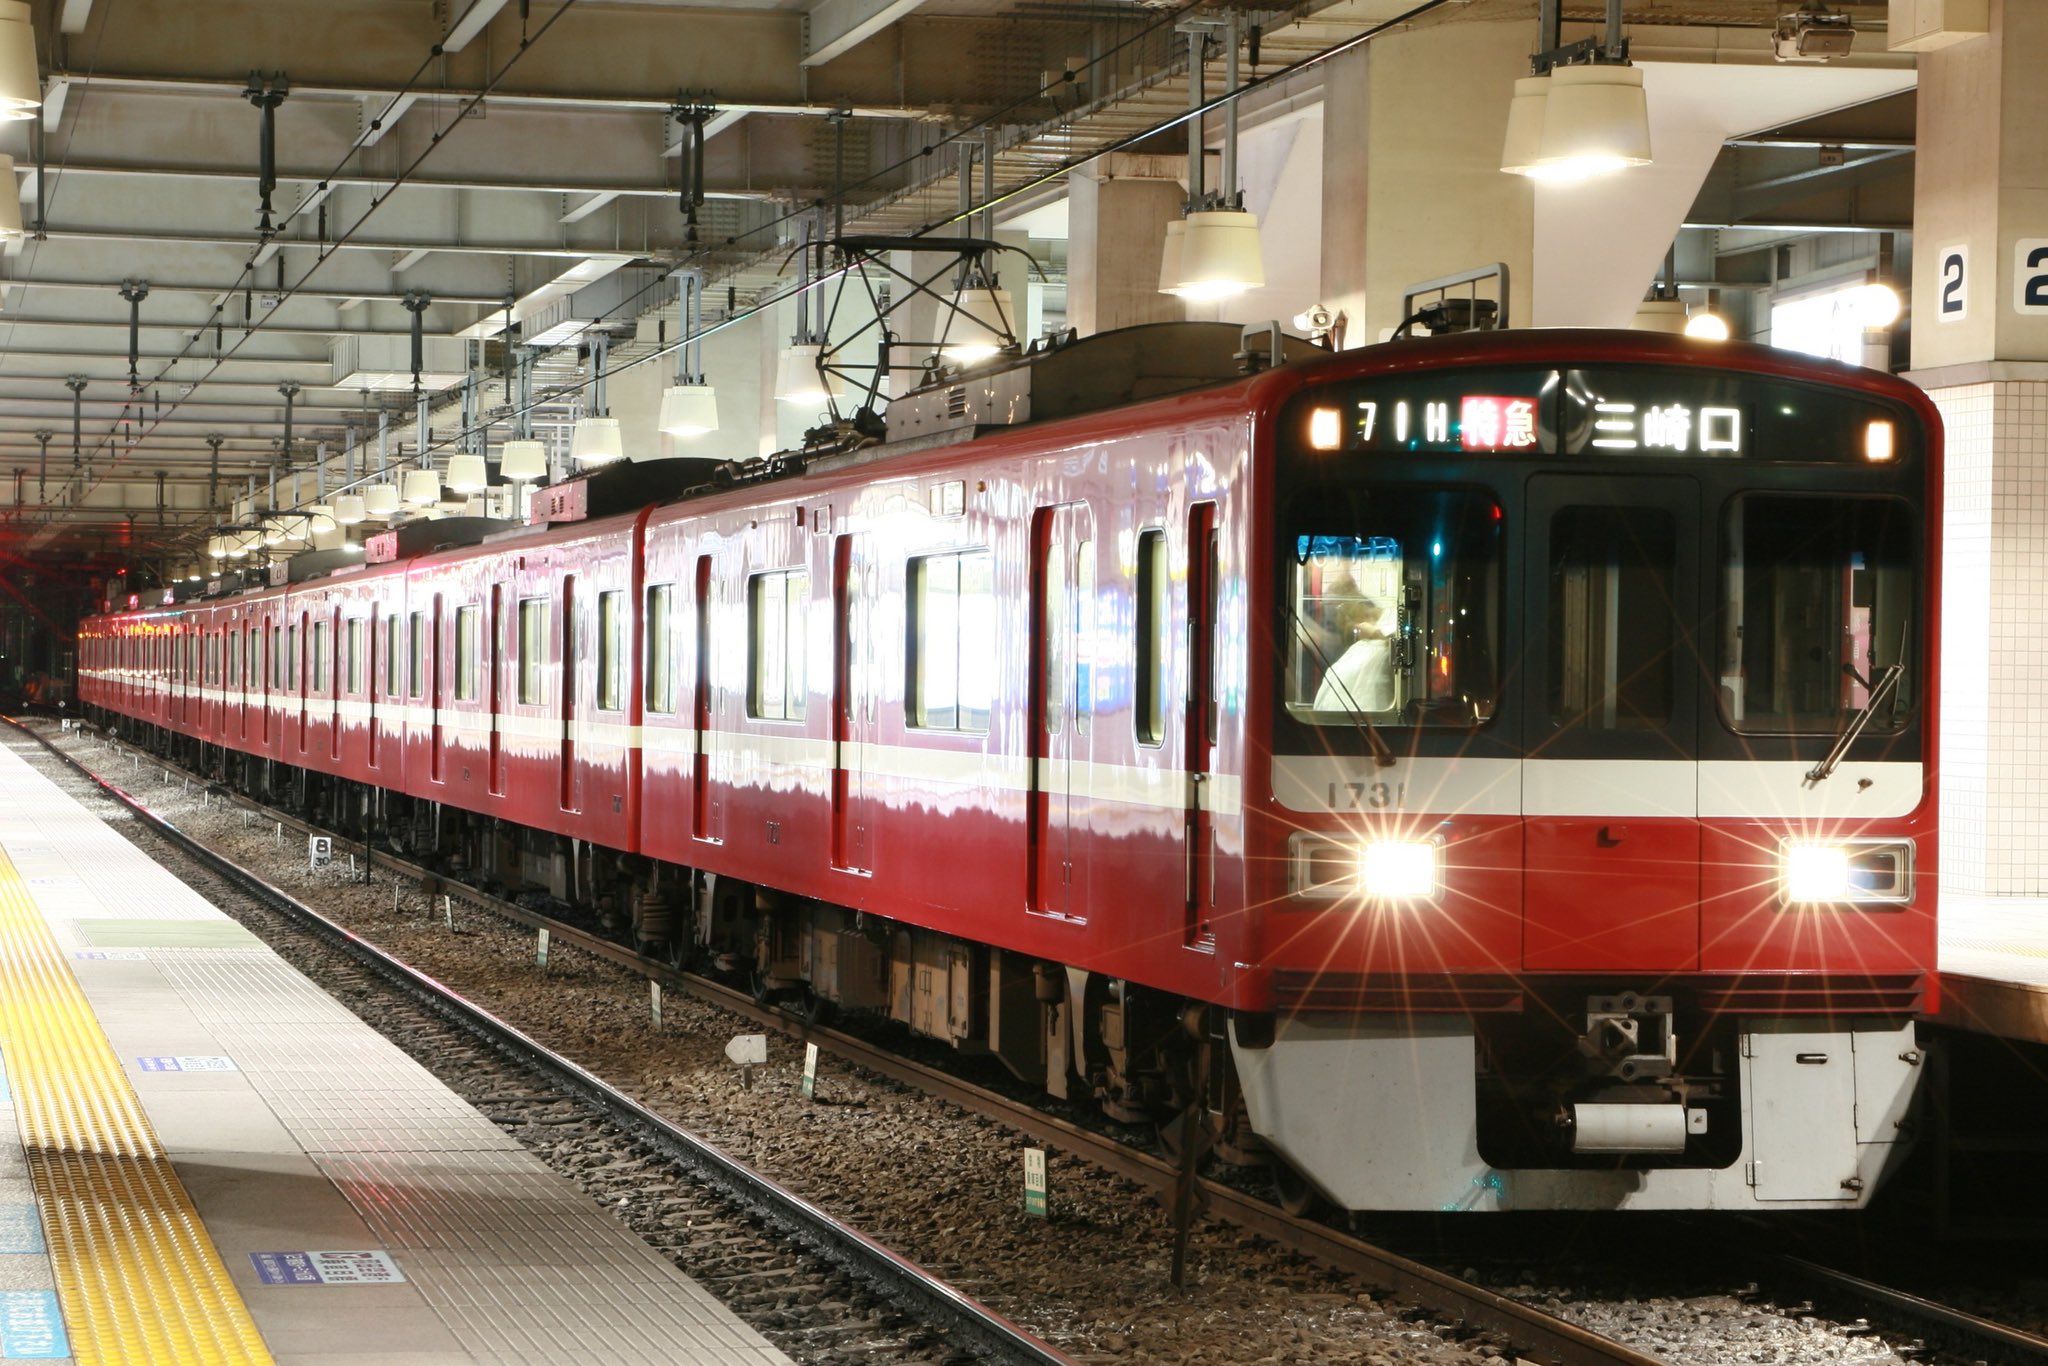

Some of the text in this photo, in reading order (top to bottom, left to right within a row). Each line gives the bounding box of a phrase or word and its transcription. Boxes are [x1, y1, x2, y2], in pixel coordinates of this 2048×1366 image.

[1942, 254, 1964, 313] 2
[1463, 400, 1537, 448] 特急
[1592, 403, 1740, 451] 三崎口
[1328, 782, 1405, 808] 1731
[316, 839, 329, 853] 8
[315, 857, 330, 867] 30
